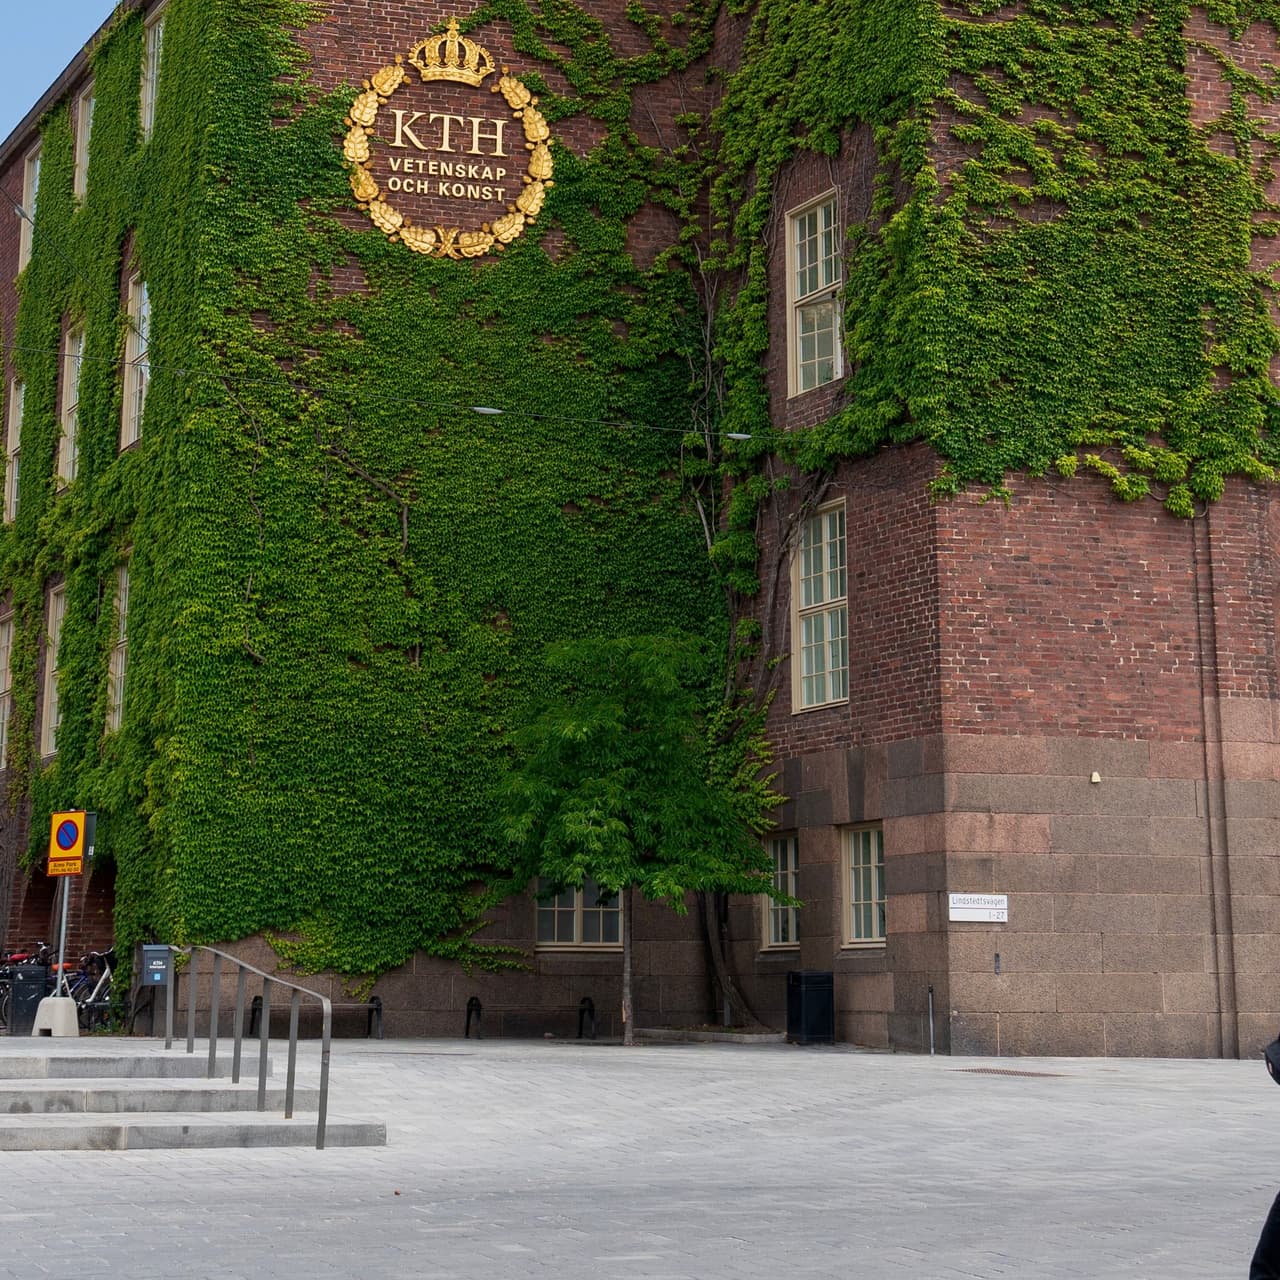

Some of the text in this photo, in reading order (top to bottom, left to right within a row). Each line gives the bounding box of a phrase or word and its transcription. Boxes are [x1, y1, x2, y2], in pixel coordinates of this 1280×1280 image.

[389, 109, 509, 157] KTH
[388, 157, 507, 182] VETENSKAP
[388, 177, 506, 201] OCH KONST
